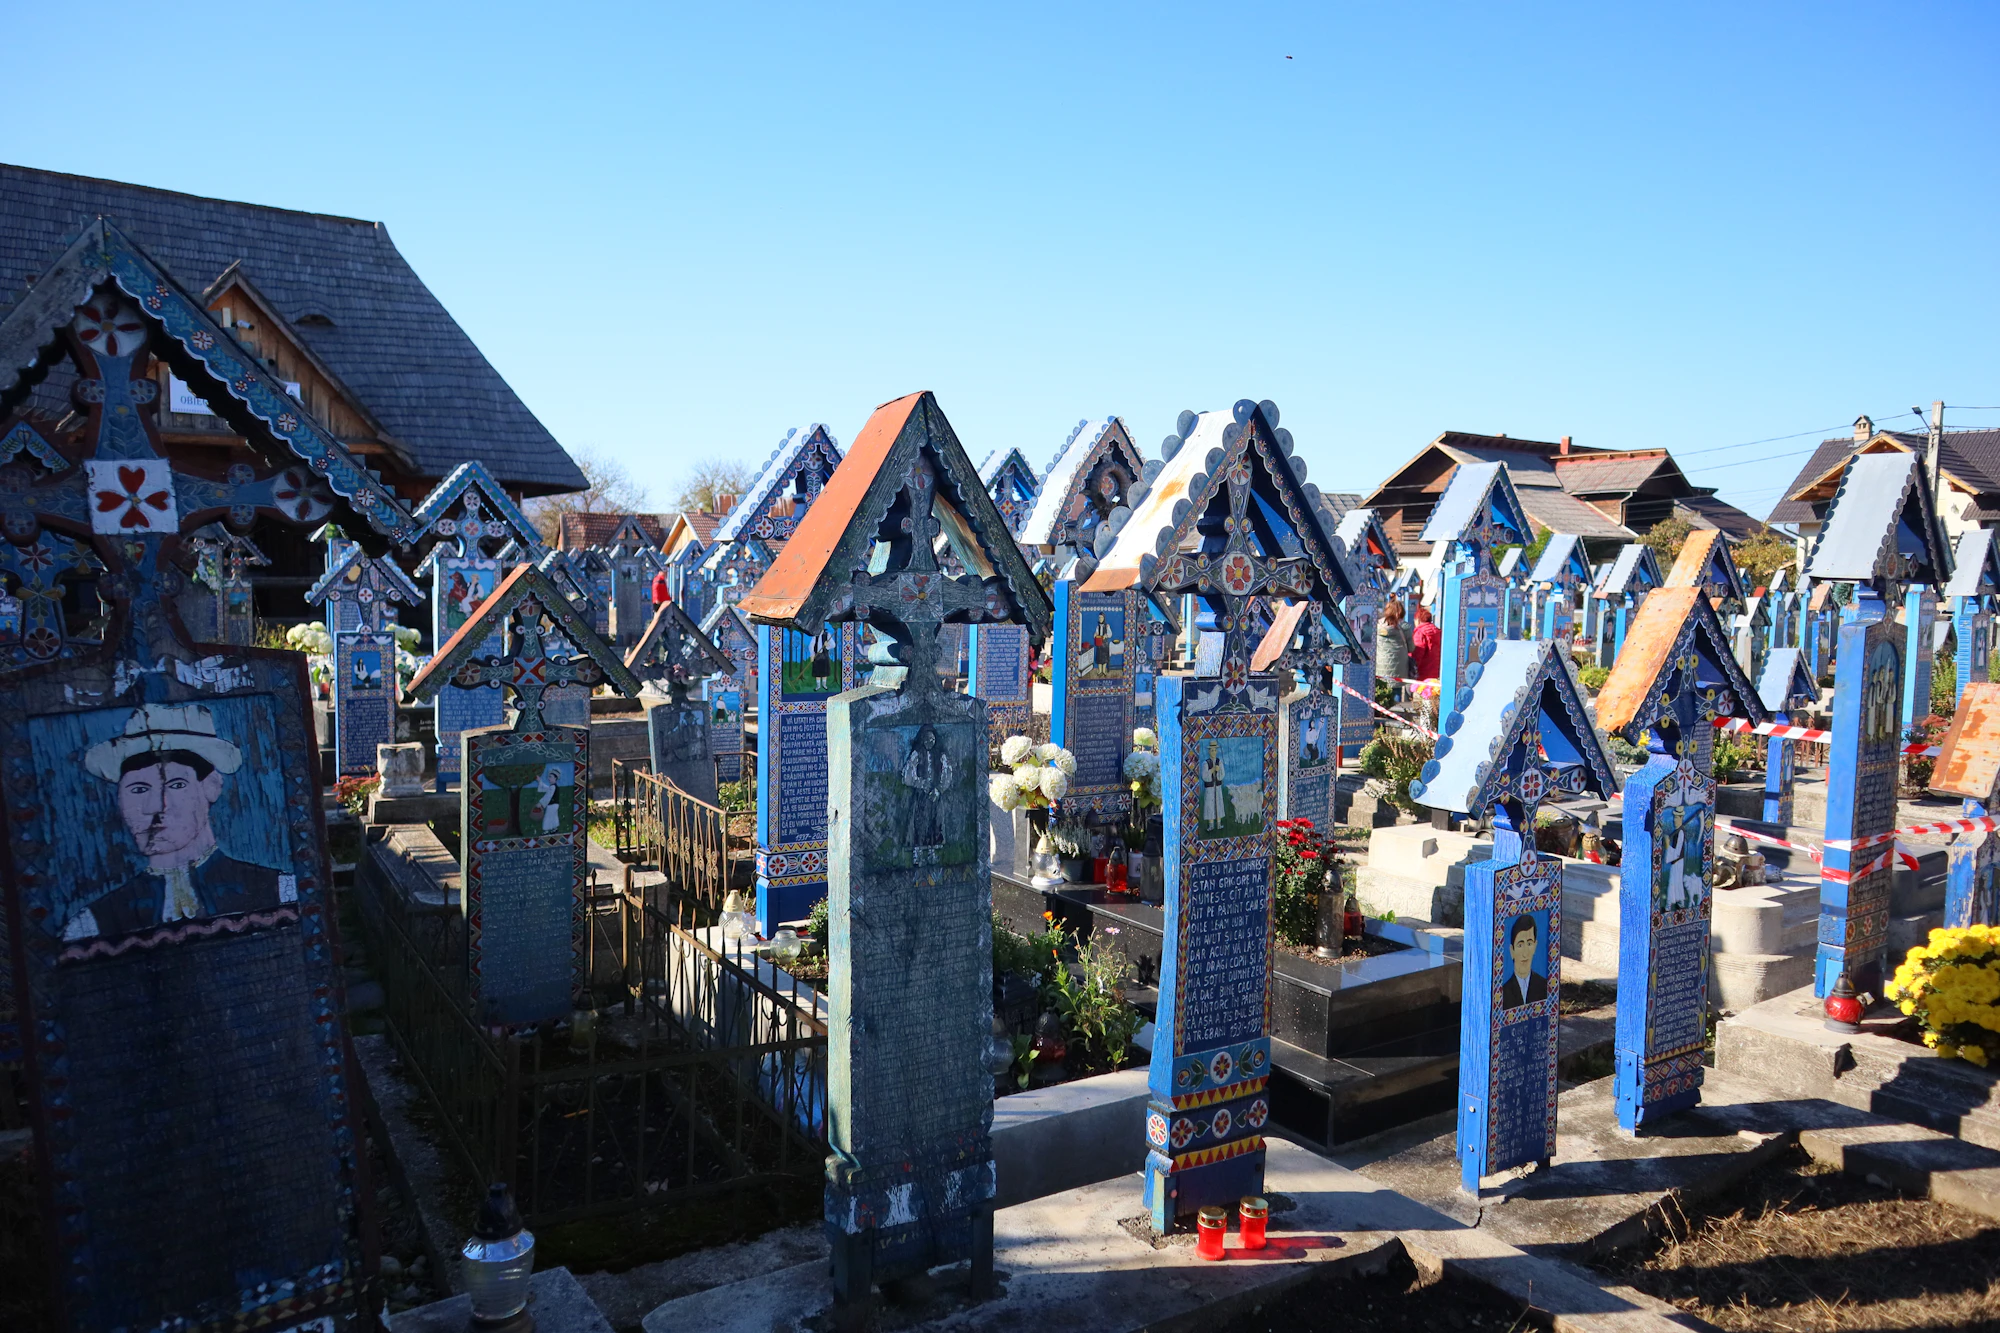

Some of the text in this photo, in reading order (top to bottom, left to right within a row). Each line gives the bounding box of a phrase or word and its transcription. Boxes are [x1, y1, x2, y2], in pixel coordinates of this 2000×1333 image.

[1192, 866, 1208, 878] AICI
[1212, 864, 1220, 876] EU
[1192, 880, 1216, 892] STAN
[1218, 874, 1250, 888] GRIGORE
[1192, 891, 1226, 905] NUMESC
[1244, 887, 1254, 898] AM
[1206, 906, 1214, 918] PE
[1191, 921, 1208, 934] OILE
[1190, 936, 1200, 948] AM
[1204, 932, 1221, 945] AVUT
[1255, 926, 1262, 937] OI
[1190, 948, 1206, 962] DAR
[1209, 944, 1230, 959] ACUM
[1189, 963, 1202, 974] VOI
[1206, 959, 1228, 972] DRAGI
[1186, 1032, 1192, 1044] A
